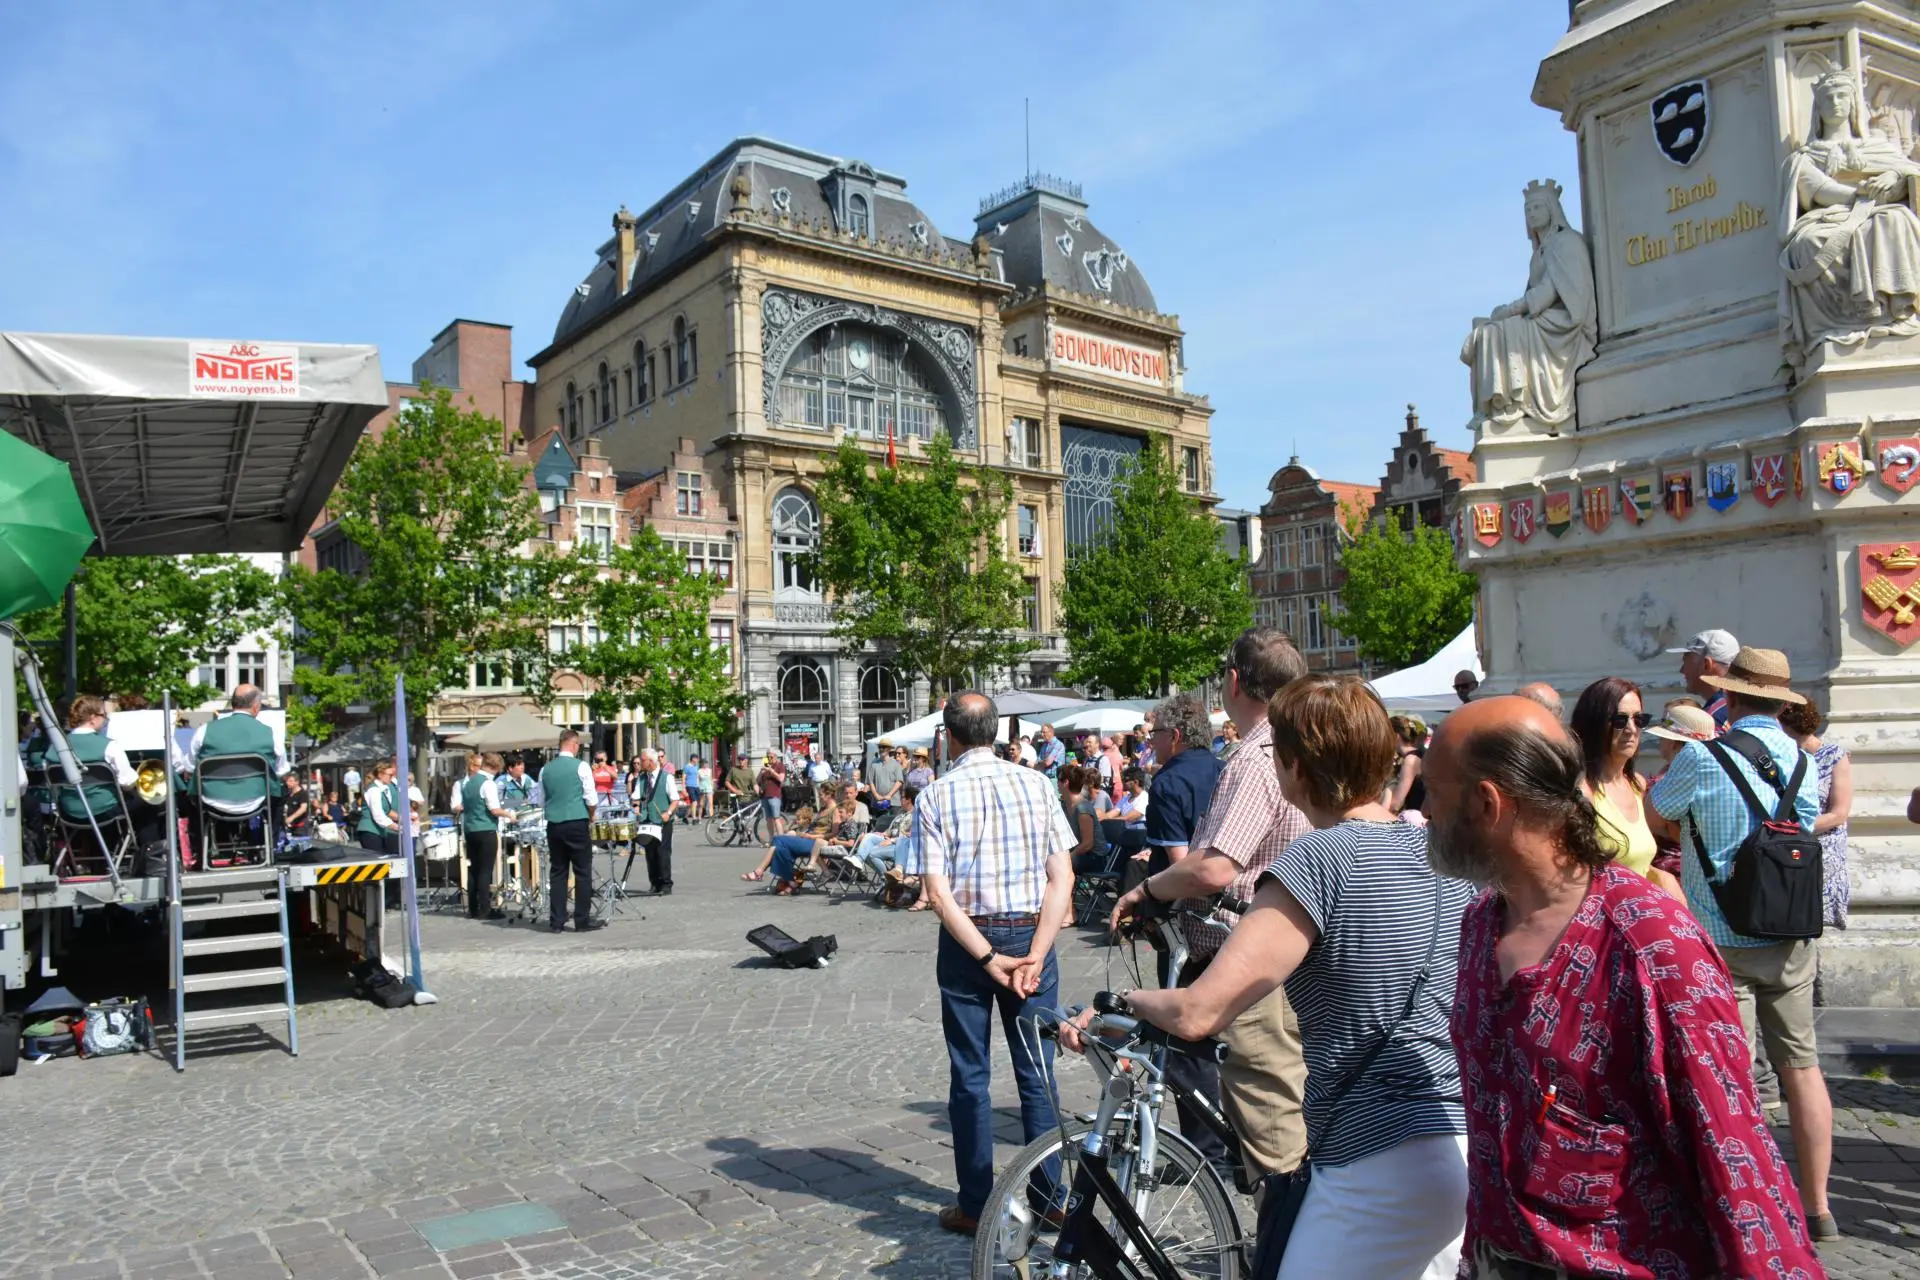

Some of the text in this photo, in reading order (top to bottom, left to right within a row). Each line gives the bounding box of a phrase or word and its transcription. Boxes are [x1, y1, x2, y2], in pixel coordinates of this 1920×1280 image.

[230, 344, 260, 357] A&C
[196, 353, 293, 381] NOYENS
[195, 384, 296, 395] www.noyens.be
